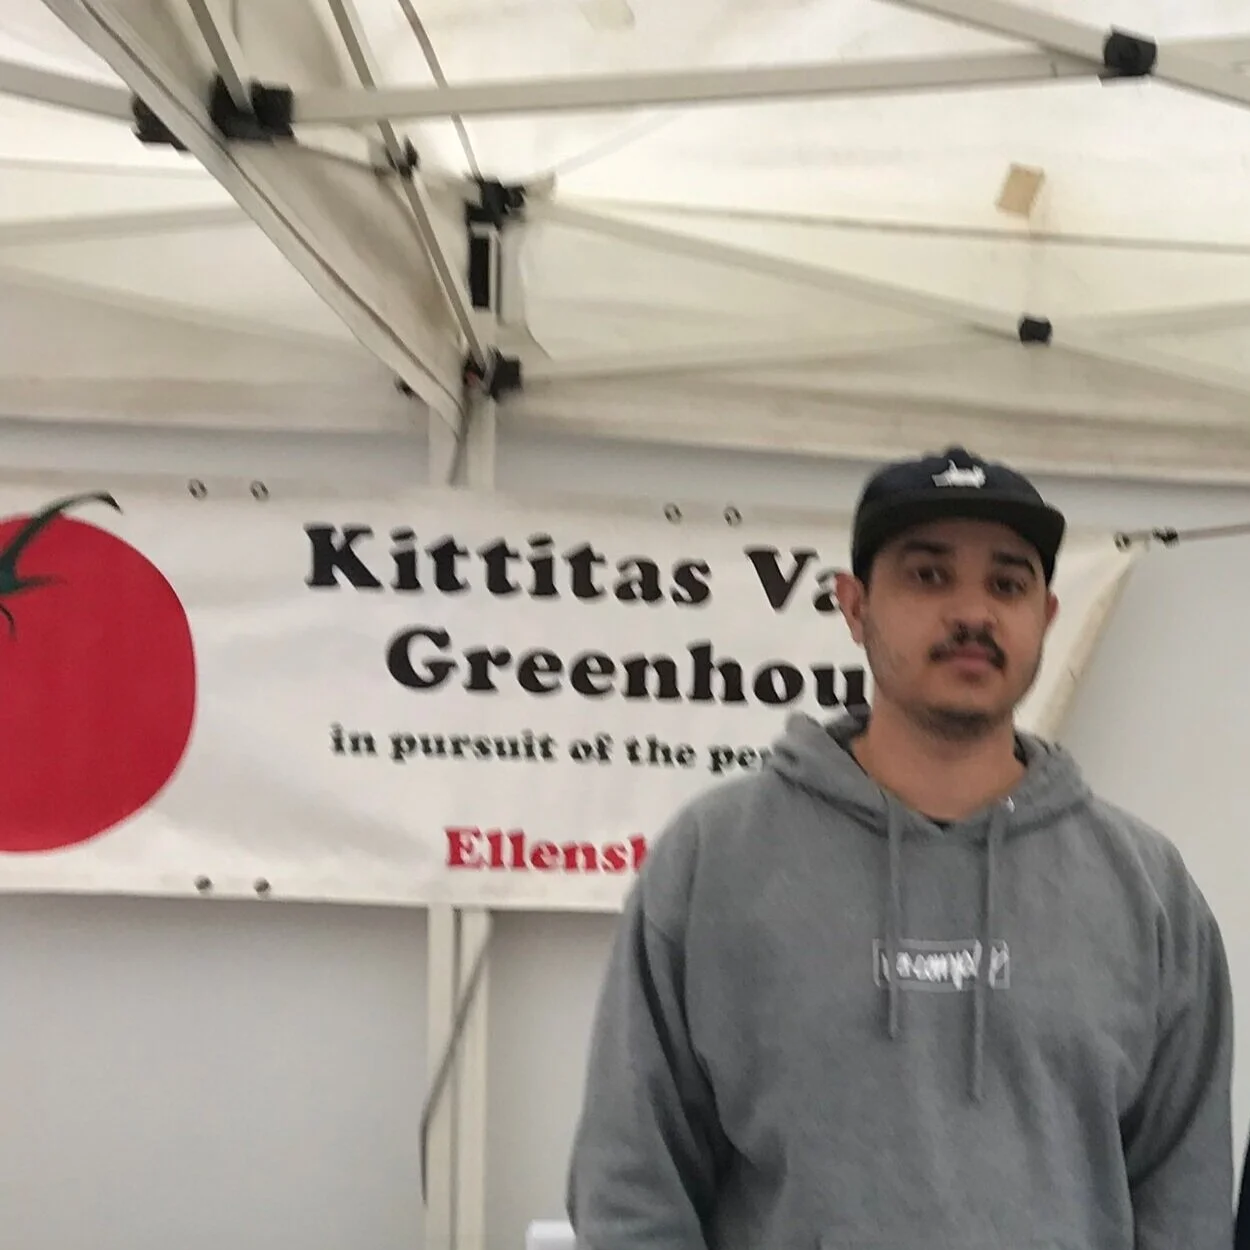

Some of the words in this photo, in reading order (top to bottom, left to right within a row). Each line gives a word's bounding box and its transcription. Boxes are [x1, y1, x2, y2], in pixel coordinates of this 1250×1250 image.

[303, 522, 712, 607] Kittitas
[387, 623, 872, 712] Greenhou
[329, 721, 378, 757] in
[390, 729, 558, 764] pursuit
[568, 733, 614, 765] of
[624, 735, 697, 768] the
